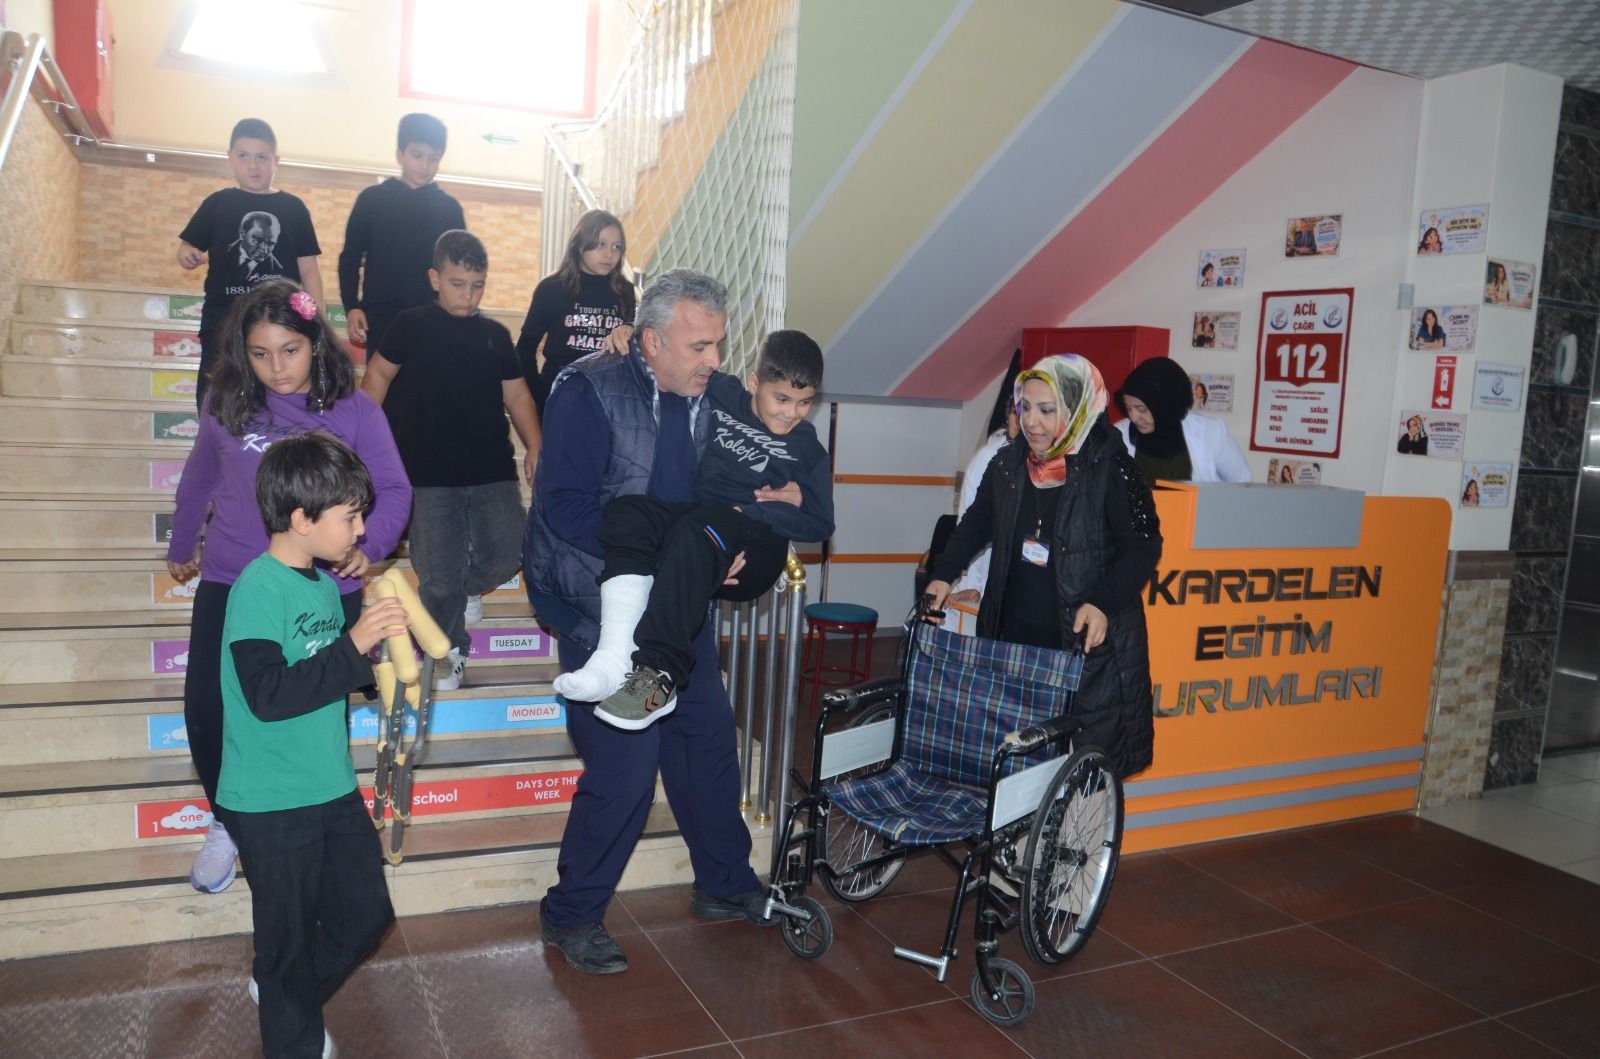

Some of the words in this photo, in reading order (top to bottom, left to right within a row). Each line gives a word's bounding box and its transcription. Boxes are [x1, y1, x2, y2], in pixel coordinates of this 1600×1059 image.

[580, 306, 601, 314] TODAY
[1294, 300, 1317, 316] ACİL
[564, 314, 603, 328] GREAT
[1293, 320, 1315, 333] ÇAĞRI
[566, 335, 605, 350] AMAZ
[1277, 343, 1327, 379] 112
[165, 529, 173, 539] 5
[1148, 565, 1382, 606] KARDELEN
[165, 659, 173, 669] 3
[495, 638, 533, 648] TUESDAY
[1152, 665, 1383, 718] URUMLARI
[162, 734, 171, 745] 2
[512, 707, 556, 718] MONDAY
[516, 779, 543, 790] DAYS
[545, 778, 560, 788] OF
[562, 776, 578, 786] THE
[413, 788, 458, 806] school
[534, 789, 560, 800] WEEK
[152, 821, 159, 833] 1
[180, 813, 203, 822] one
